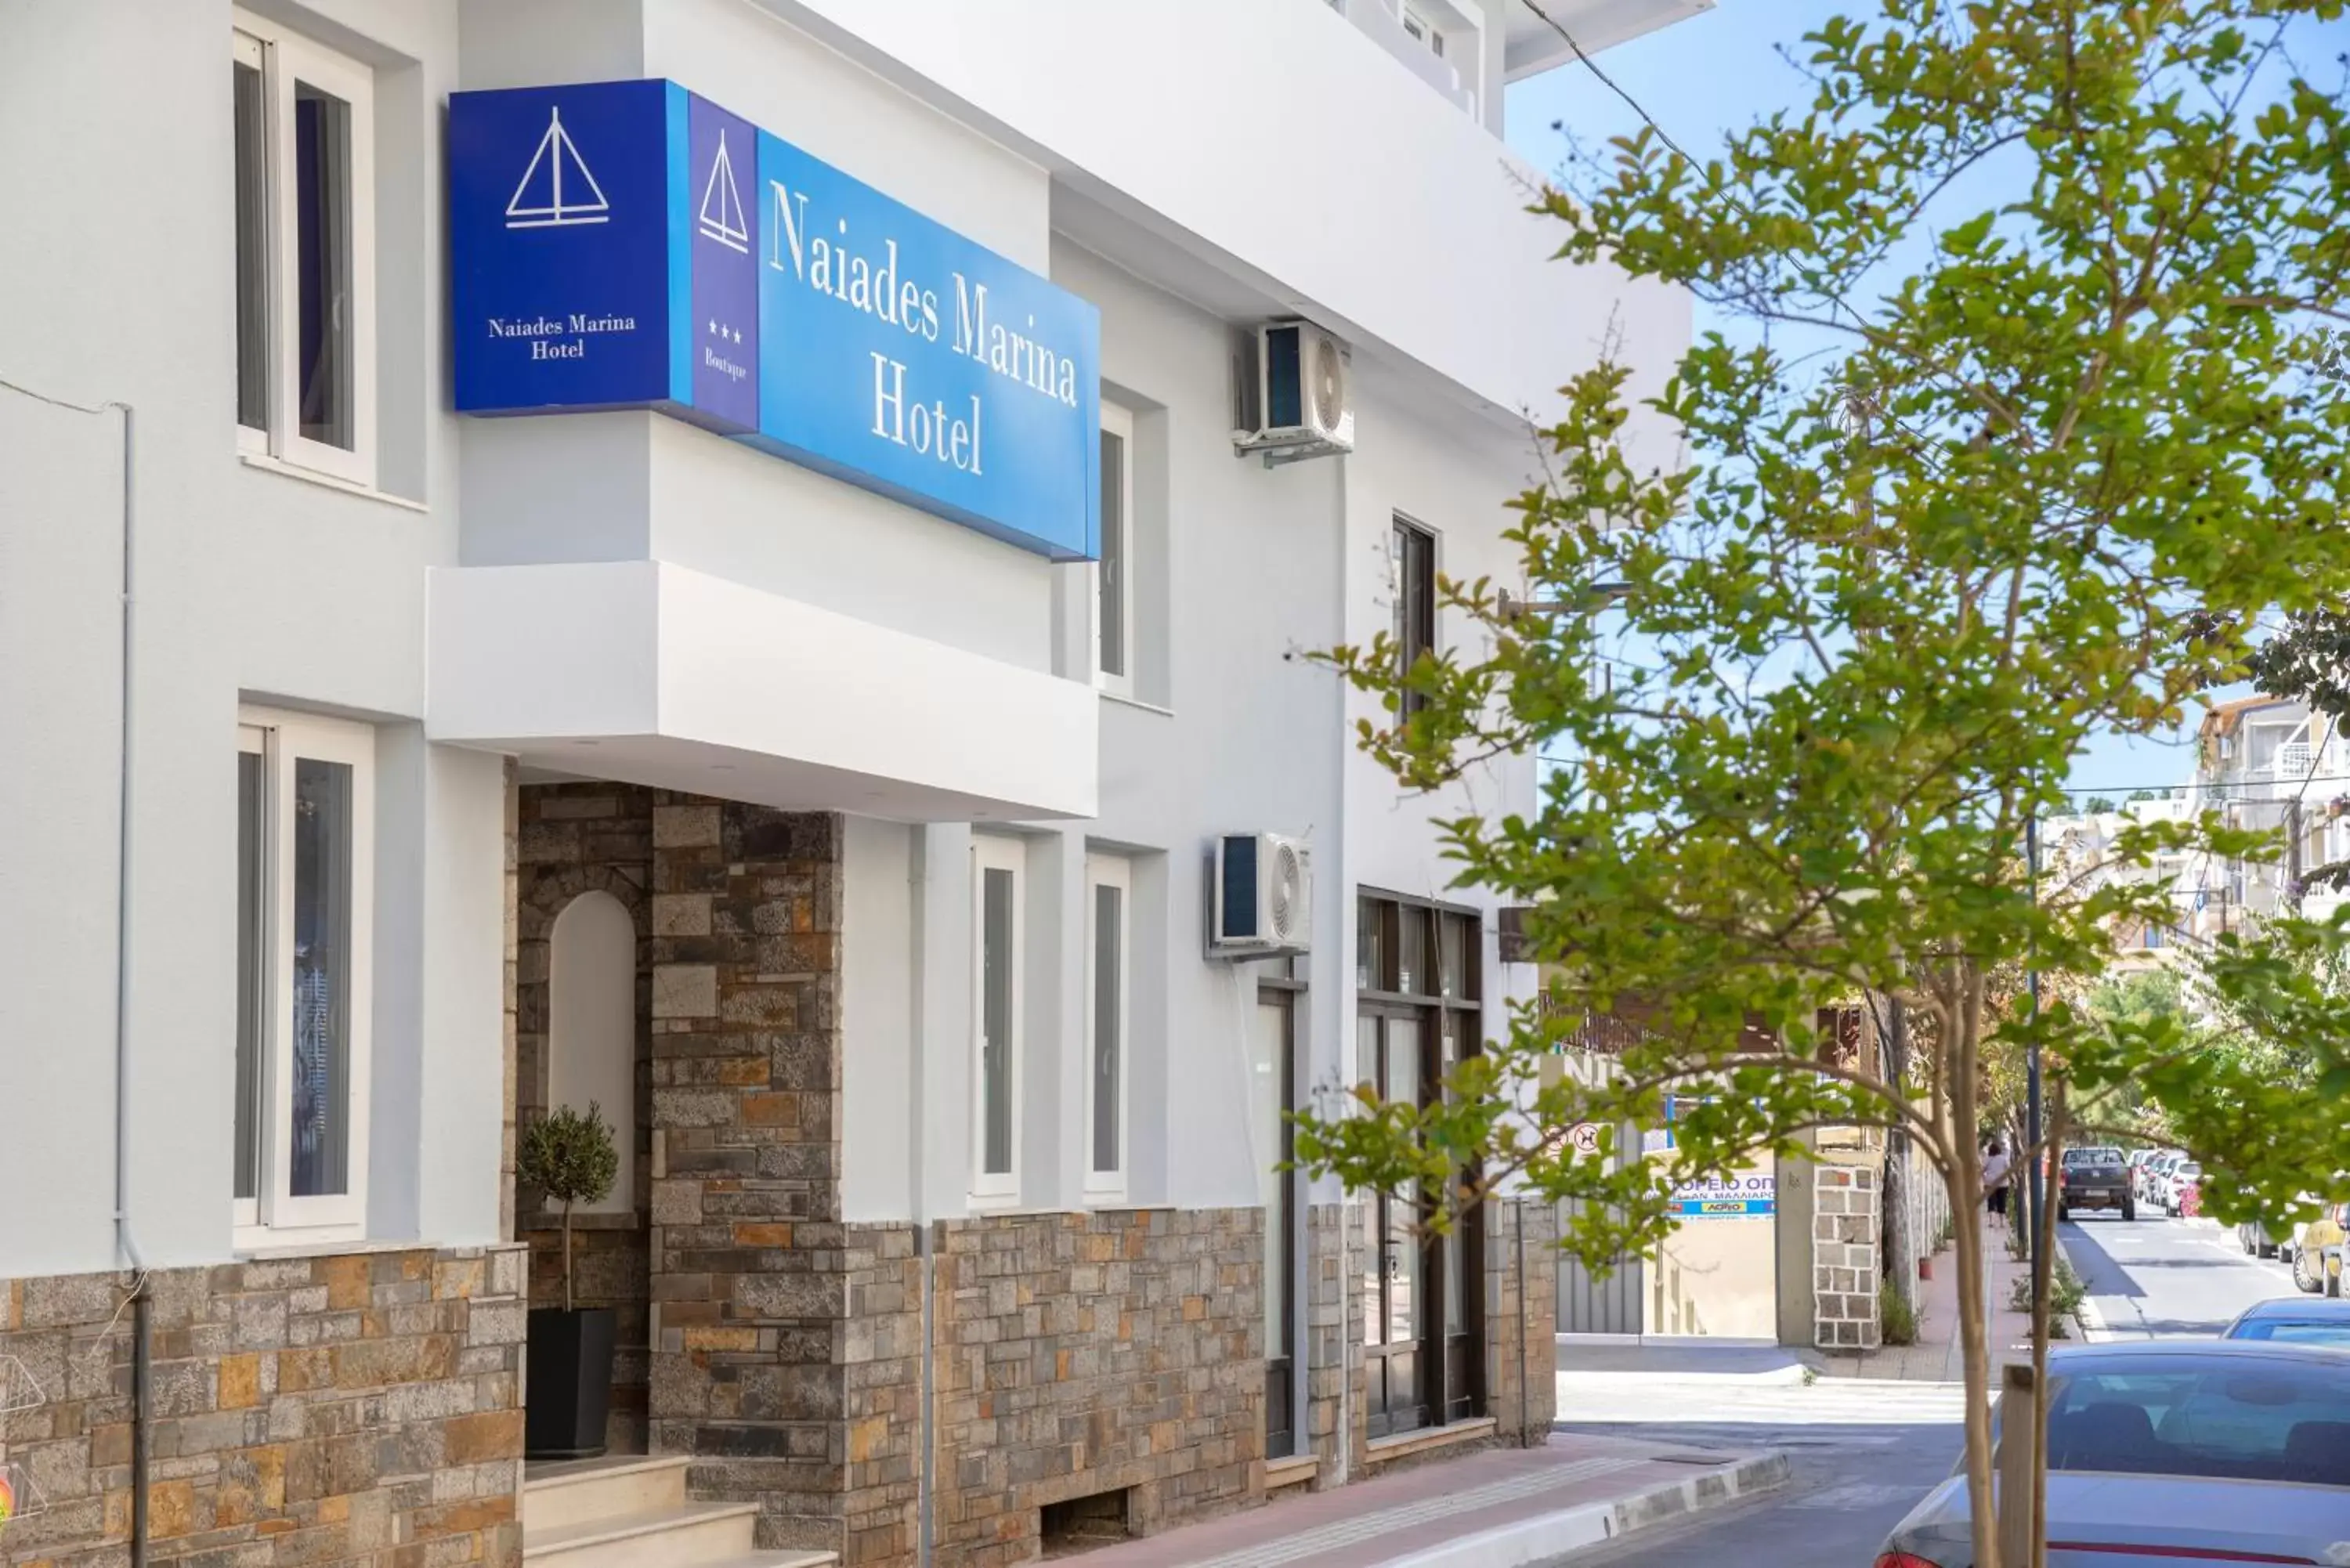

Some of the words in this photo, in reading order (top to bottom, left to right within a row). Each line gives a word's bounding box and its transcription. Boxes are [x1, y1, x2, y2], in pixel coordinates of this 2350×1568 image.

[488, 316, 563, 338] Naiades
[569, 313, 636, 334] Marina
[769, 179, 939, 342] Naiades
[952, 272, 1078, 408] Marina
[531, 338, 584, 359] Hotel
[870, 351, 982, 476] Hotel
